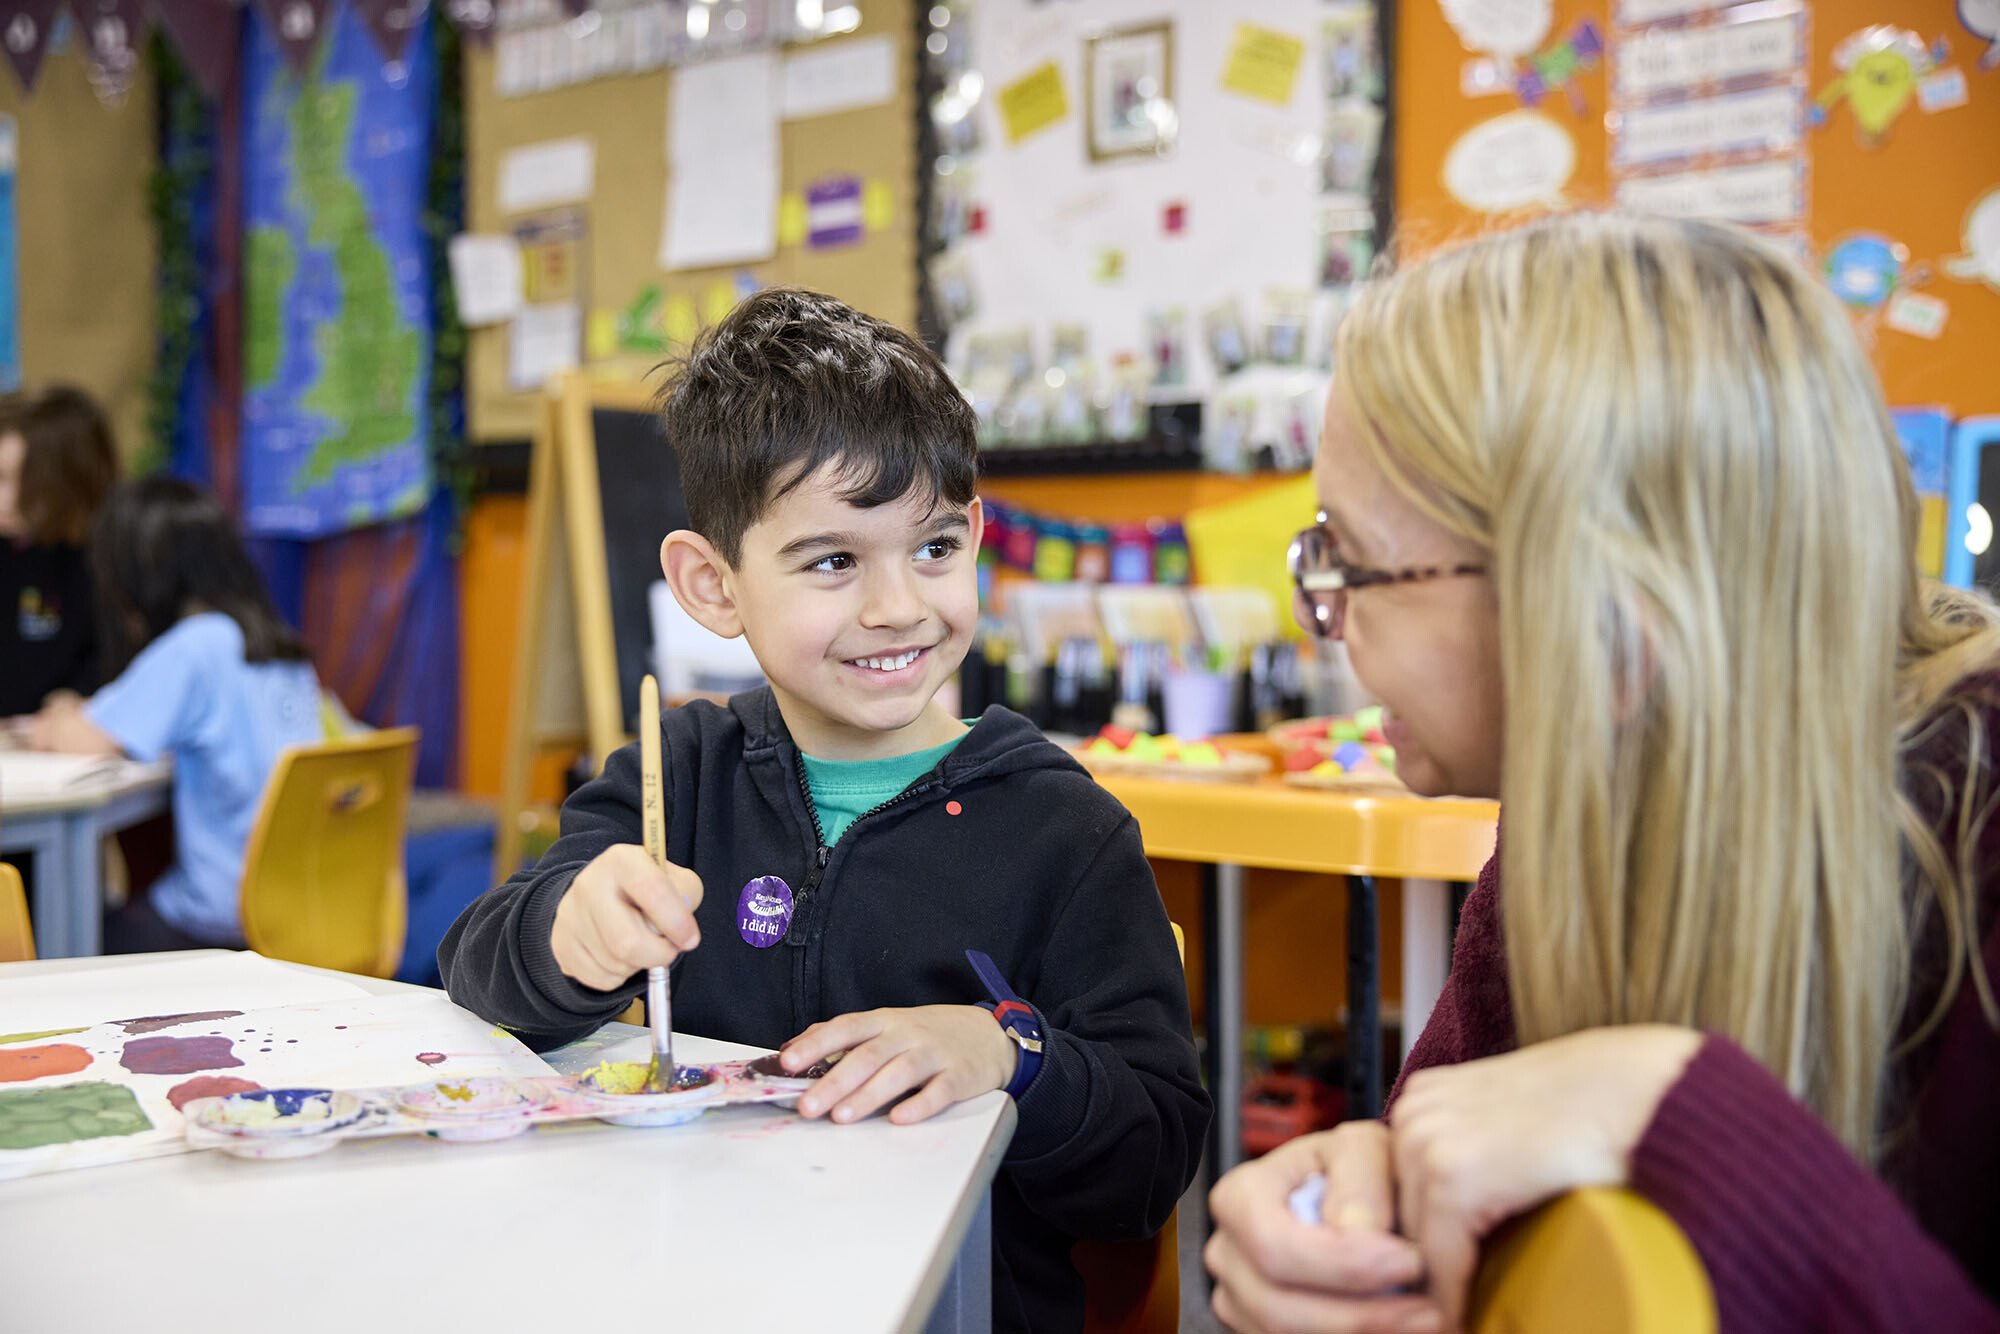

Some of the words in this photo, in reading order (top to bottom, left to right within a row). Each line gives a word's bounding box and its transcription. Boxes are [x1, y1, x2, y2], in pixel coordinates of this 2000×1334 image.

[742, 918, 748, 930] I
[748, 919, 767, 933] did
[767, 922, 779, 936] it!
